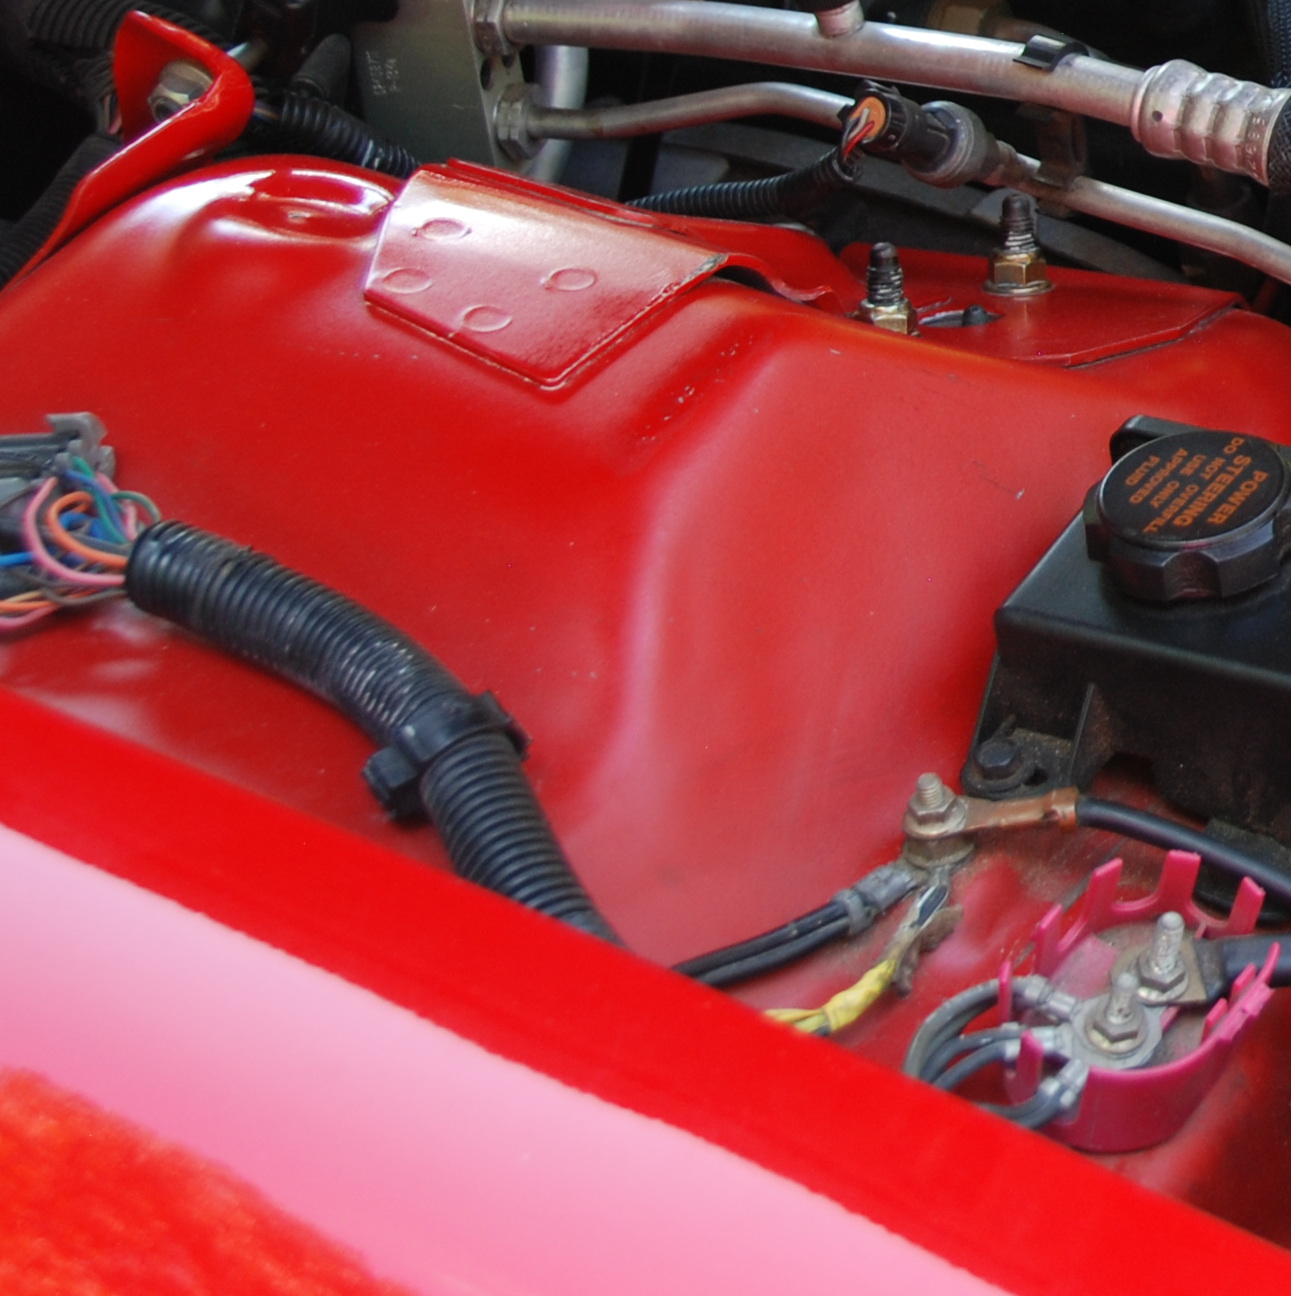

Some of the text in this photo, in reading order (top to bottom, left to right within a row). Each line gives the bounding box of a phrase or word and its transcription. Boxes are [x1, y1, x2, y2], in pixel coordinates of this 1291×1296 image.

[1124, 454, 1161, 487] FLUID
[1128, 447, 1190, 505] APPROVED
[1142, 436, 1245, 533] DO NOT OVERFILL
[1148, 453, 1208, 509] USE ONLY
[1171, 453, 1253, 527] STEERING
[1205, 469, 1270, 526] POWER
